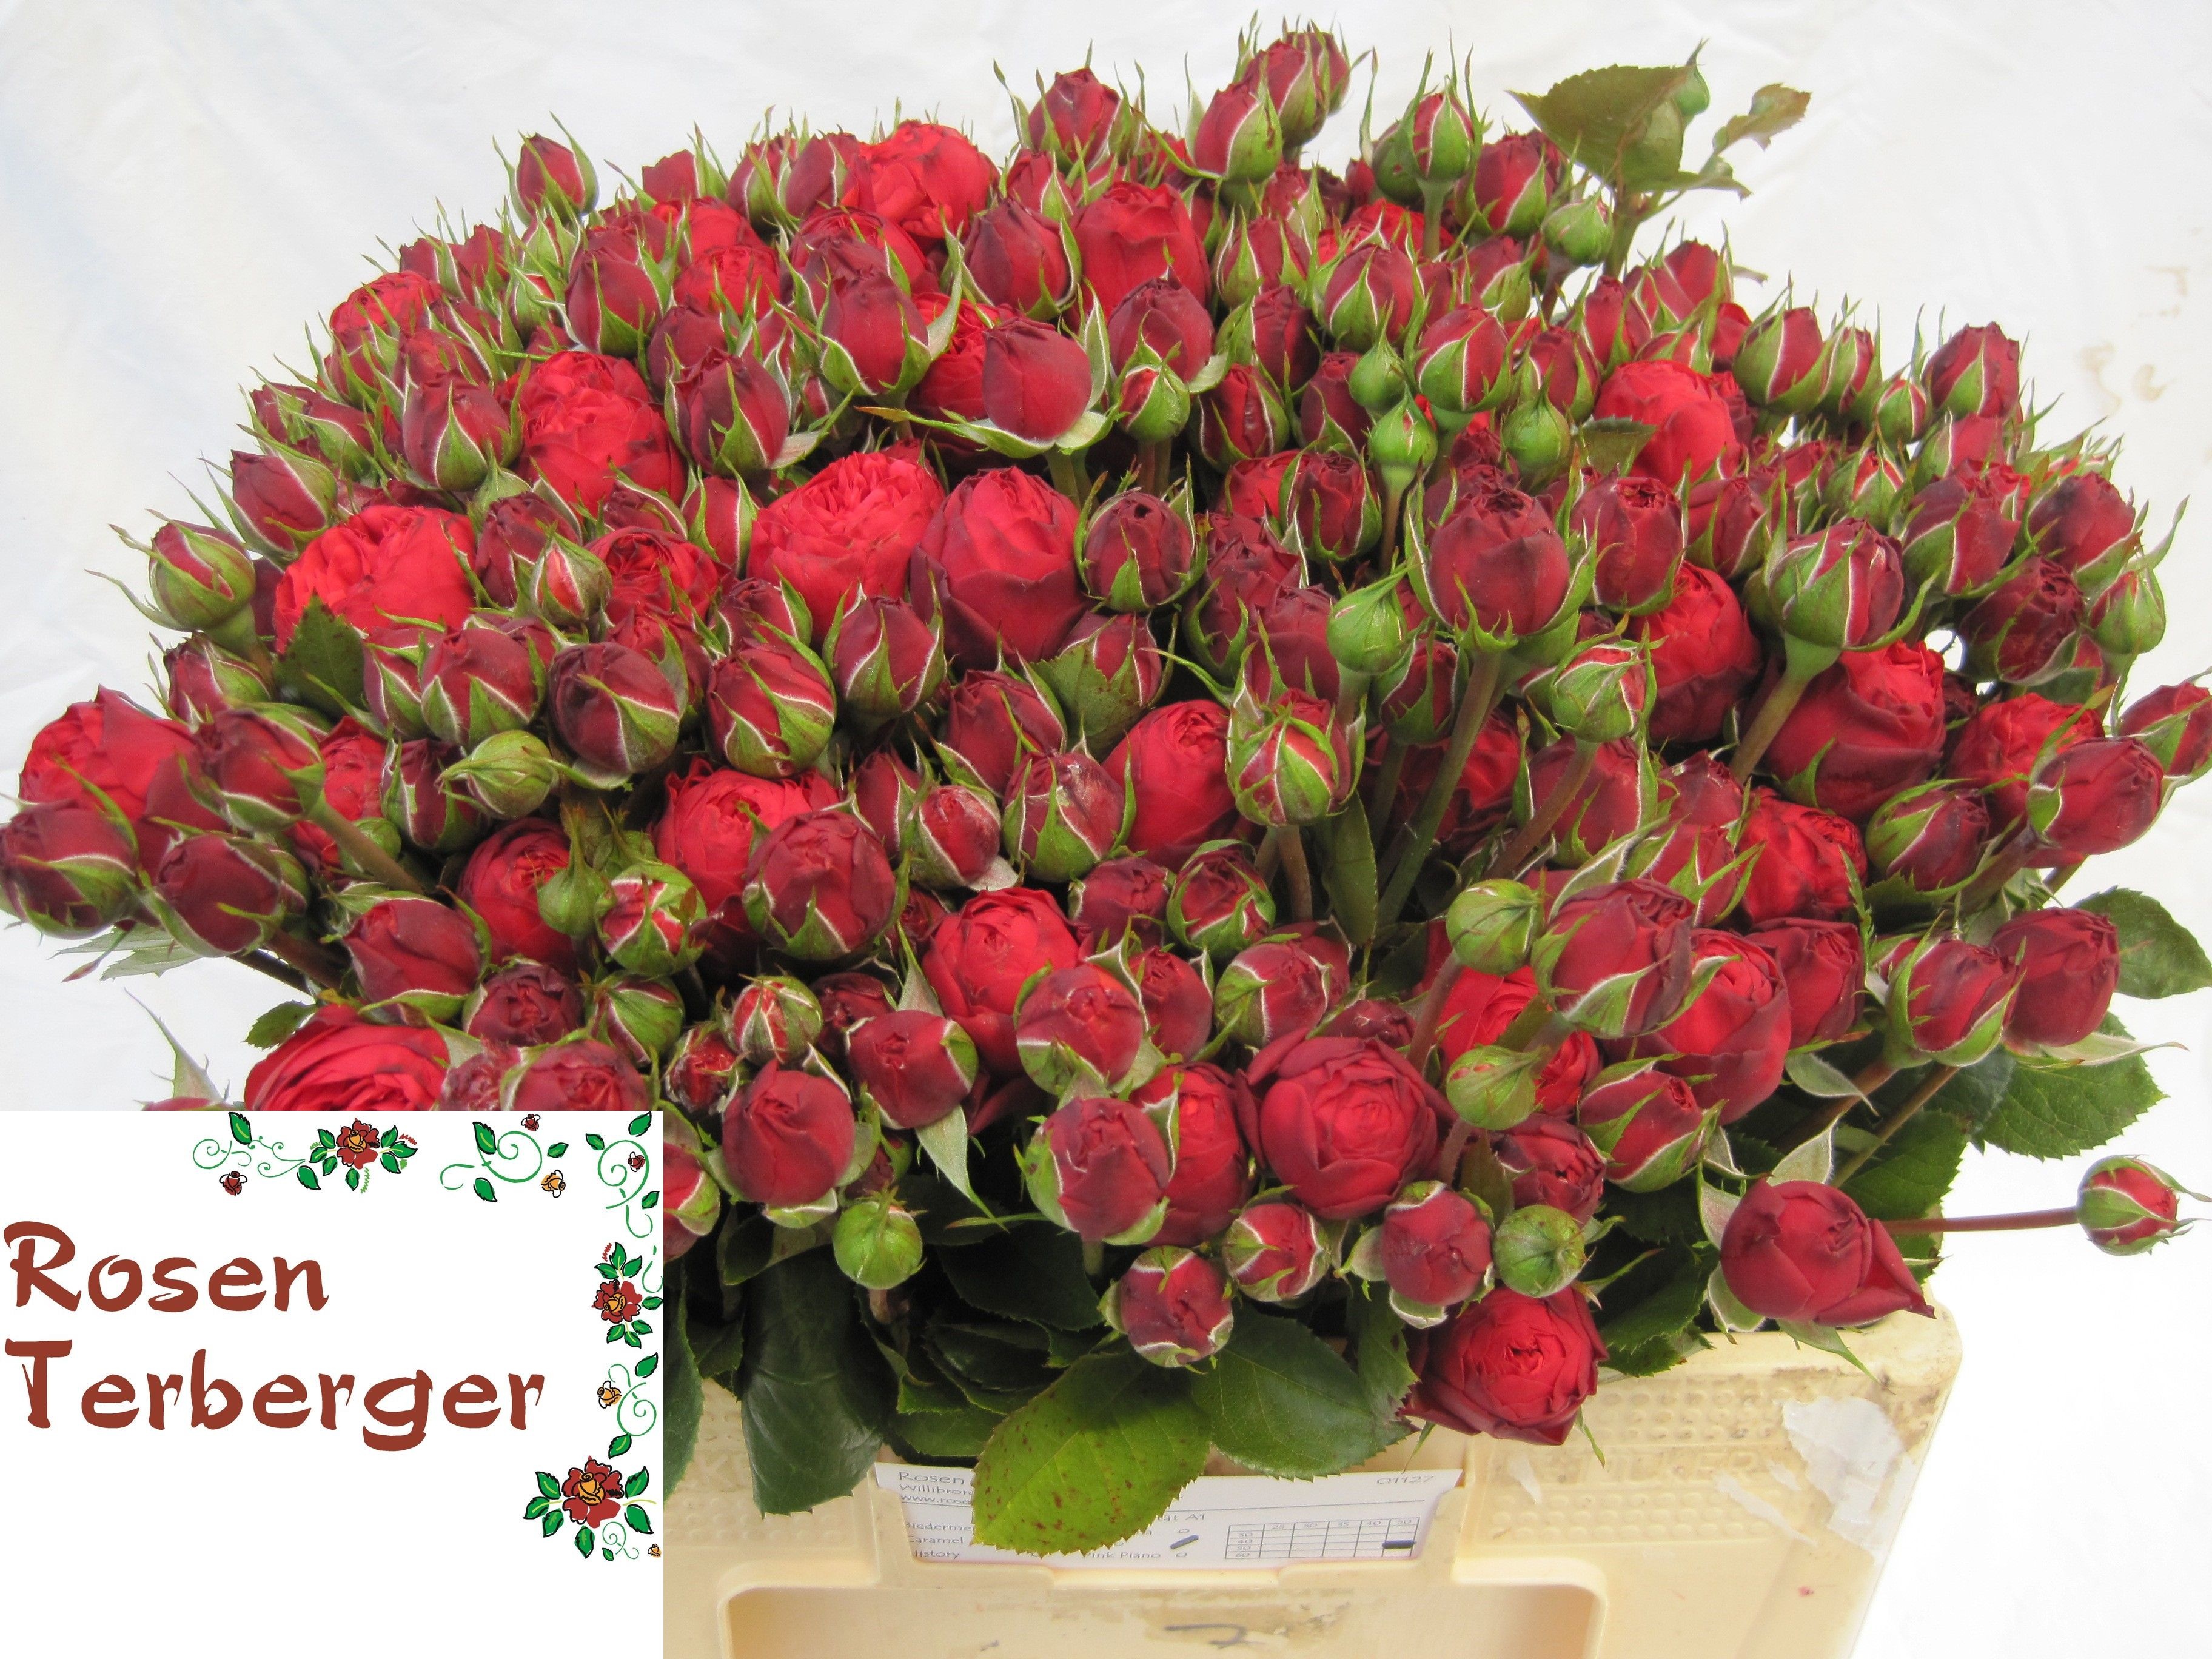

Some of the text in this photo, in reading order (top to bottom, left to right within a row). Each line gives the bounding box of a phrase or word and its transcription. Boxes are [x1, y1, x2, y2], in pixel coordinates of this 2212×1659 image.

[899, 1471, 965, 1485] Rosen
[900, 1494, 971, 1505] www.rose
[906, 1521, 973, 1531] Biederme
